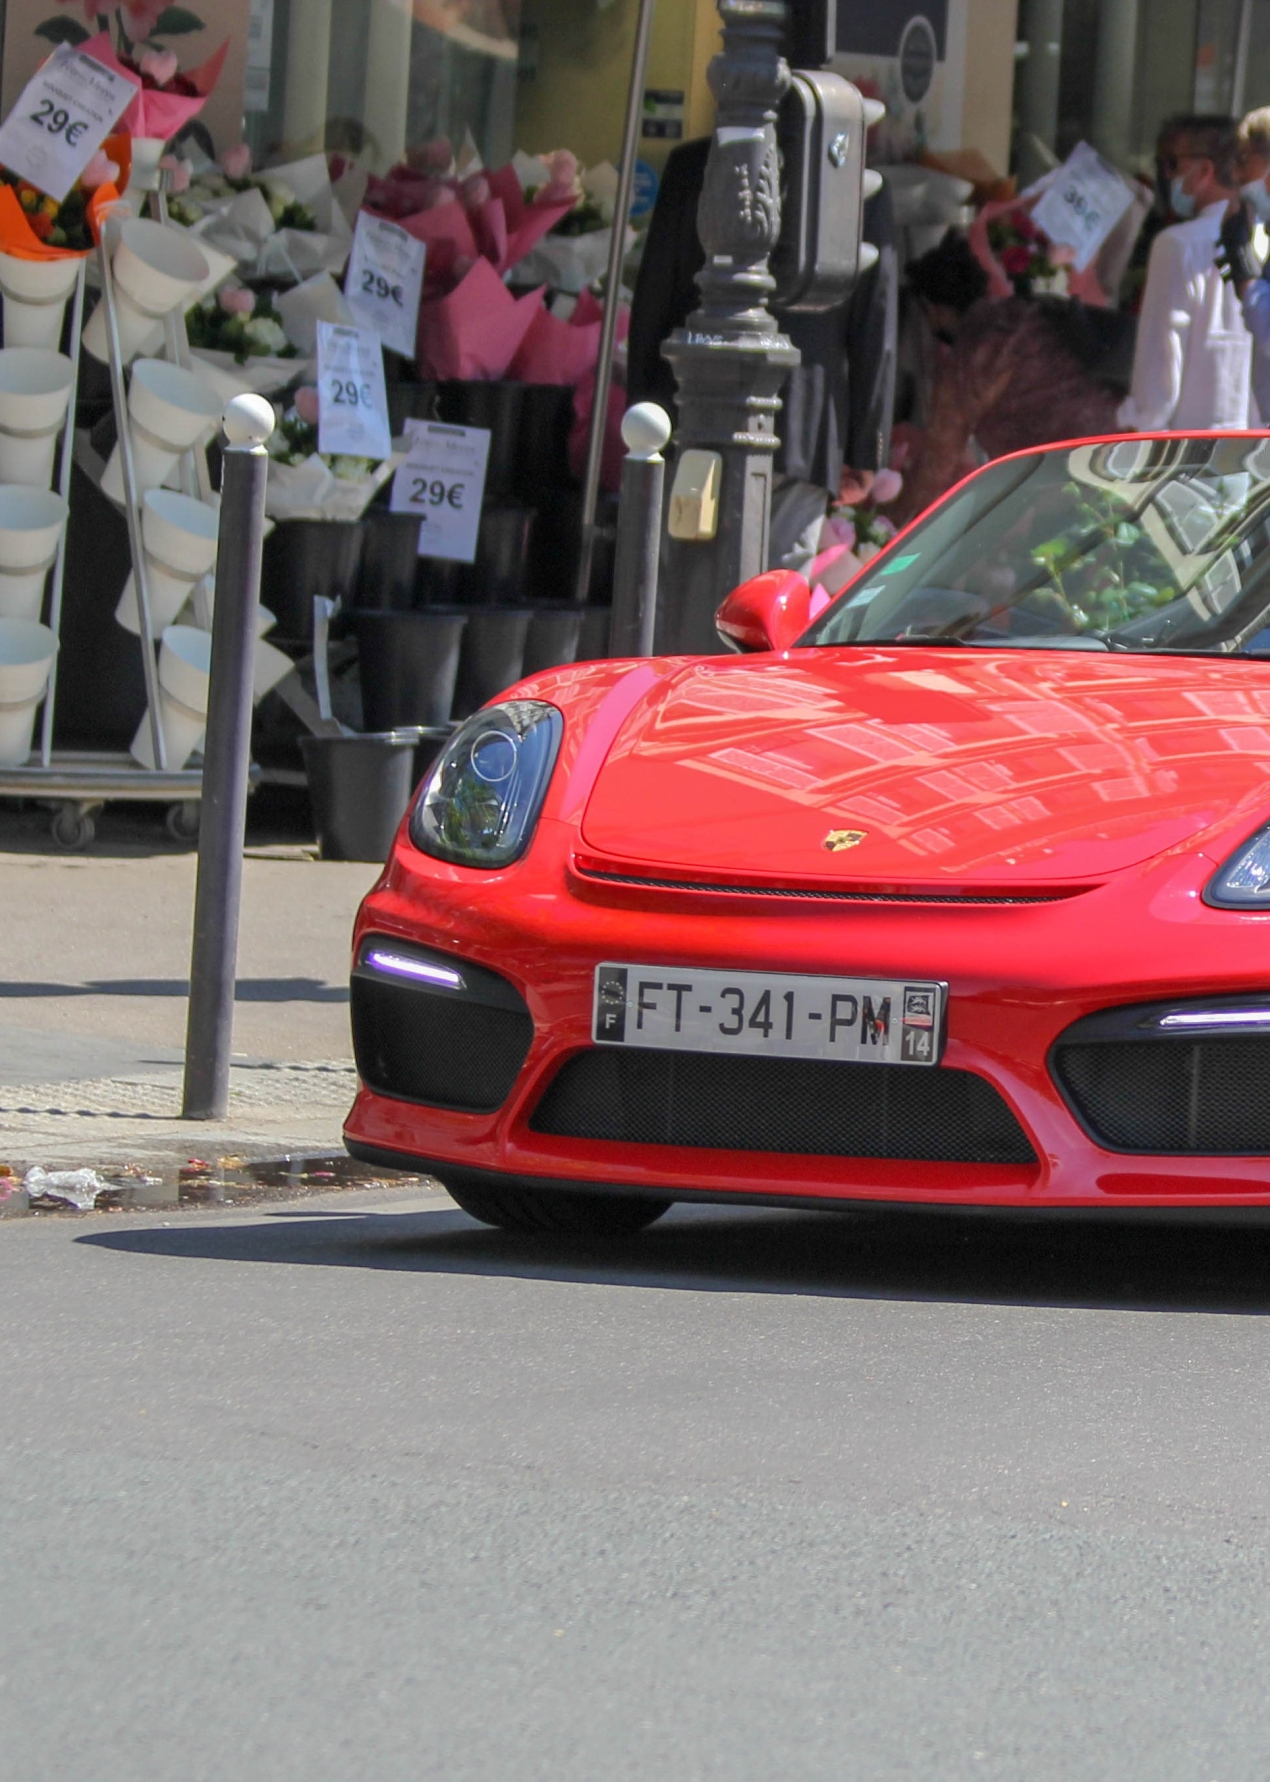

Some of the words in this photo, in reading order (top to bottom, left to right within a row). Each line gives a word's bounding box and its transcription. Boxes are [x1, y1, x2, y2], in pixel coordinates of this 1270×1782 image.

[30, 98, 89, 147] 29€
[362, 270, 404, 308] 29€
[331, 379, 373, 409] 29€
[409, 478, 465, 509] 29€
[605, 1013, 617, 1029] F
[637, 981, 892, 1046] FT-341-PM
[905, 1031, 930, 1056] 14
